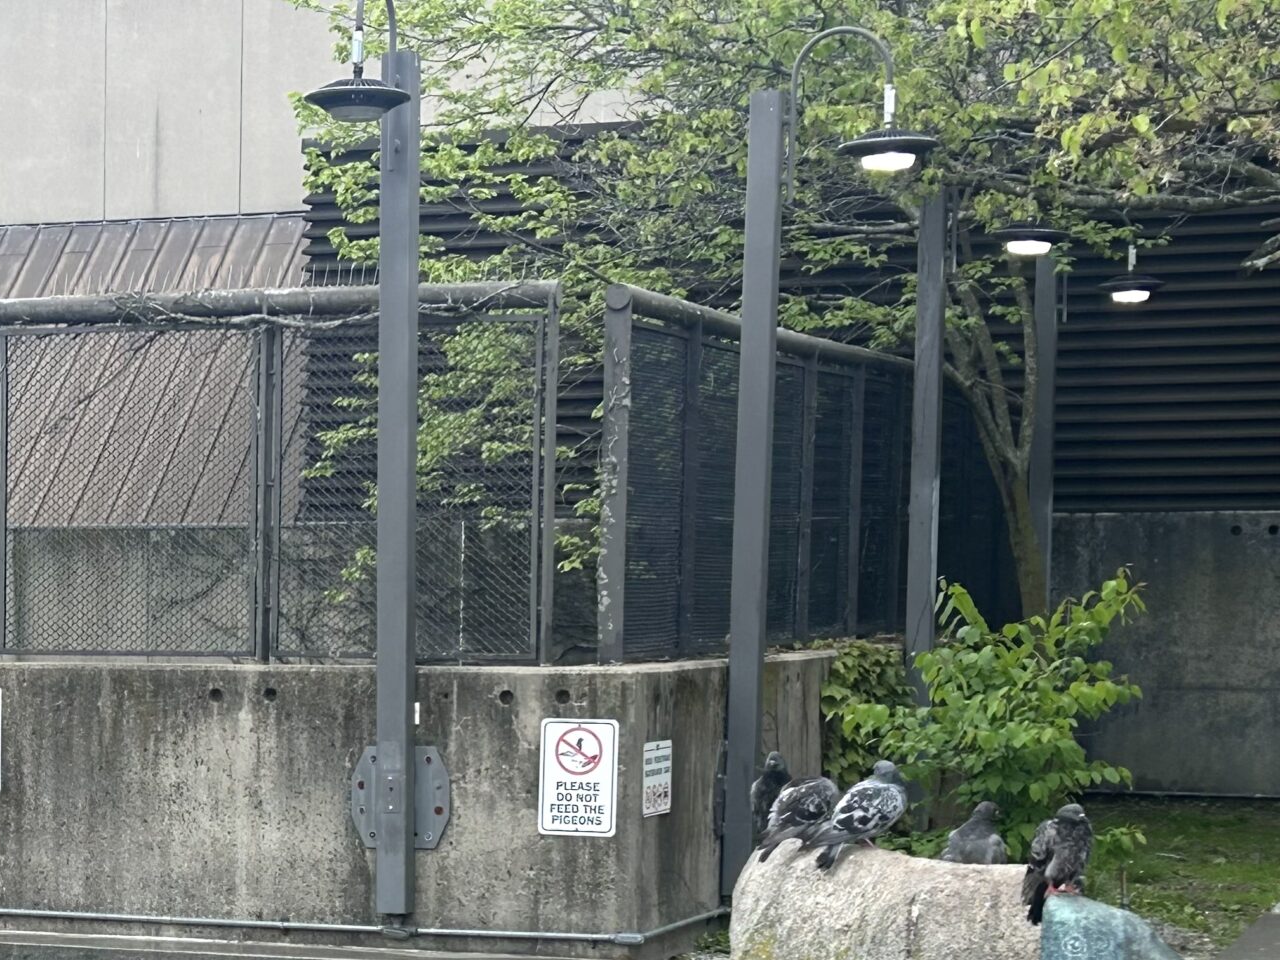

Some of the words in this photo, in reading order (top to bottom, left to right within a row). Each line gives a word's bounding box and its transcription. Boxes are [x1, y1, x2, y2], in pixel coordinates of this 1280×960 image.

[556, 781, 601, 792] PLEASE
[556, 792, 573, 802] DO
[576, 793, 600, 803] NOT
[550, 803, 579, 813] FEED
[582, 804, 606, 815] THE
[551, 815, 603, 826] PIGEONS
